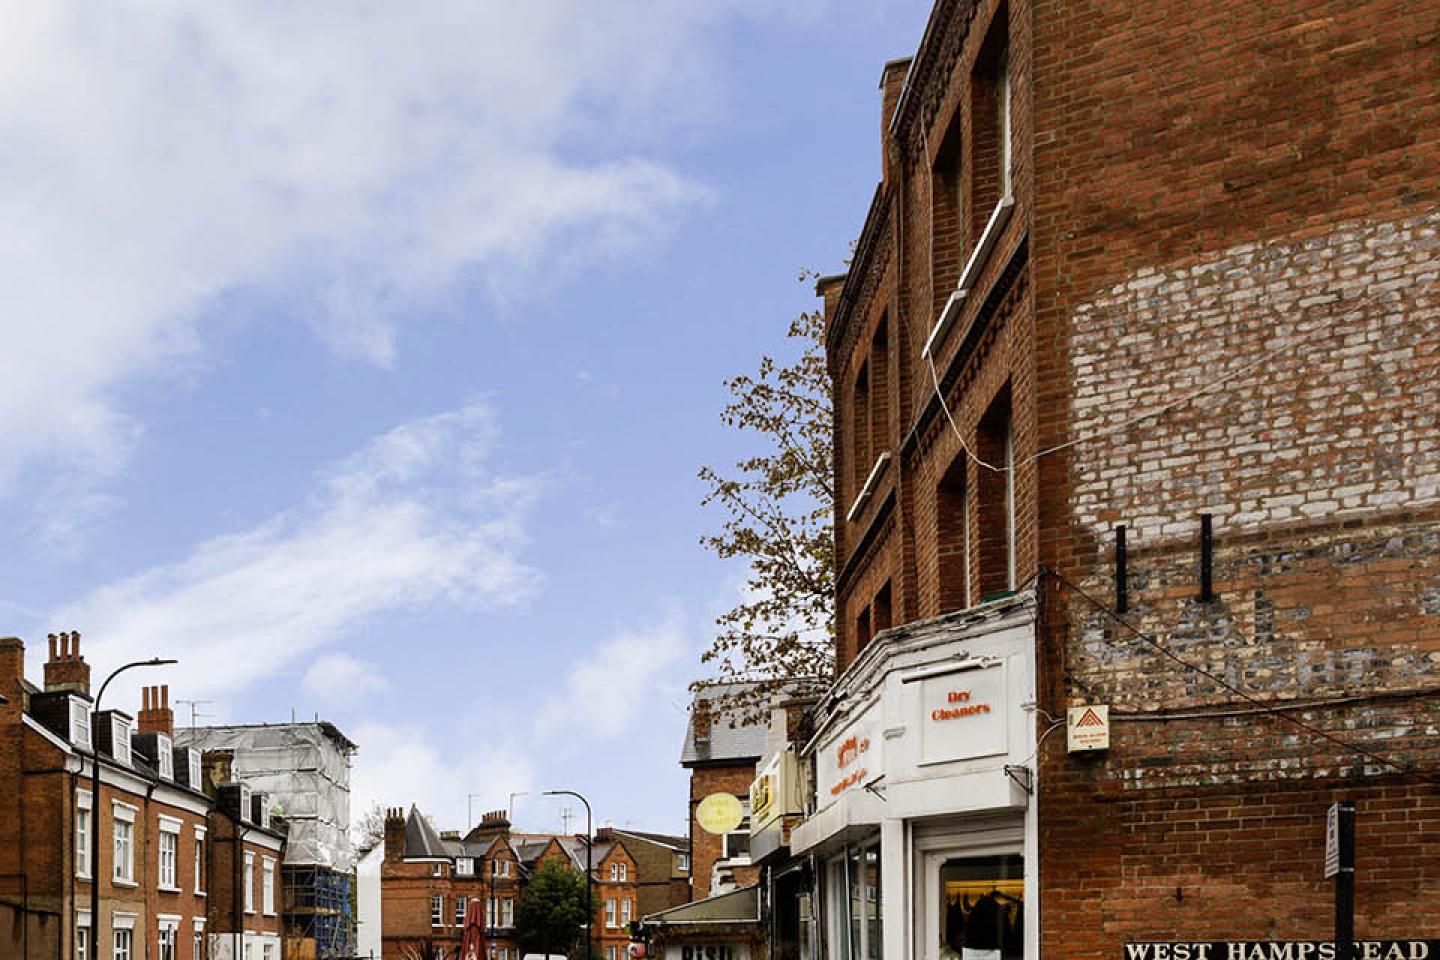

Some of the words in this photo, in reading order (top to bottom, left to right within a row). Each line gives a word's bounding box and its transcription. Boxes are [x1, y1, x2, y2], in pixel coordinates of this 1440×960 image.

[947, 691, 970, 704] Dry
[931, 704, 991, 721] Cleaners
[1125, 942, 1211, 960] WEST
[1227, 941, 1429, 960] HAMPSEAD
